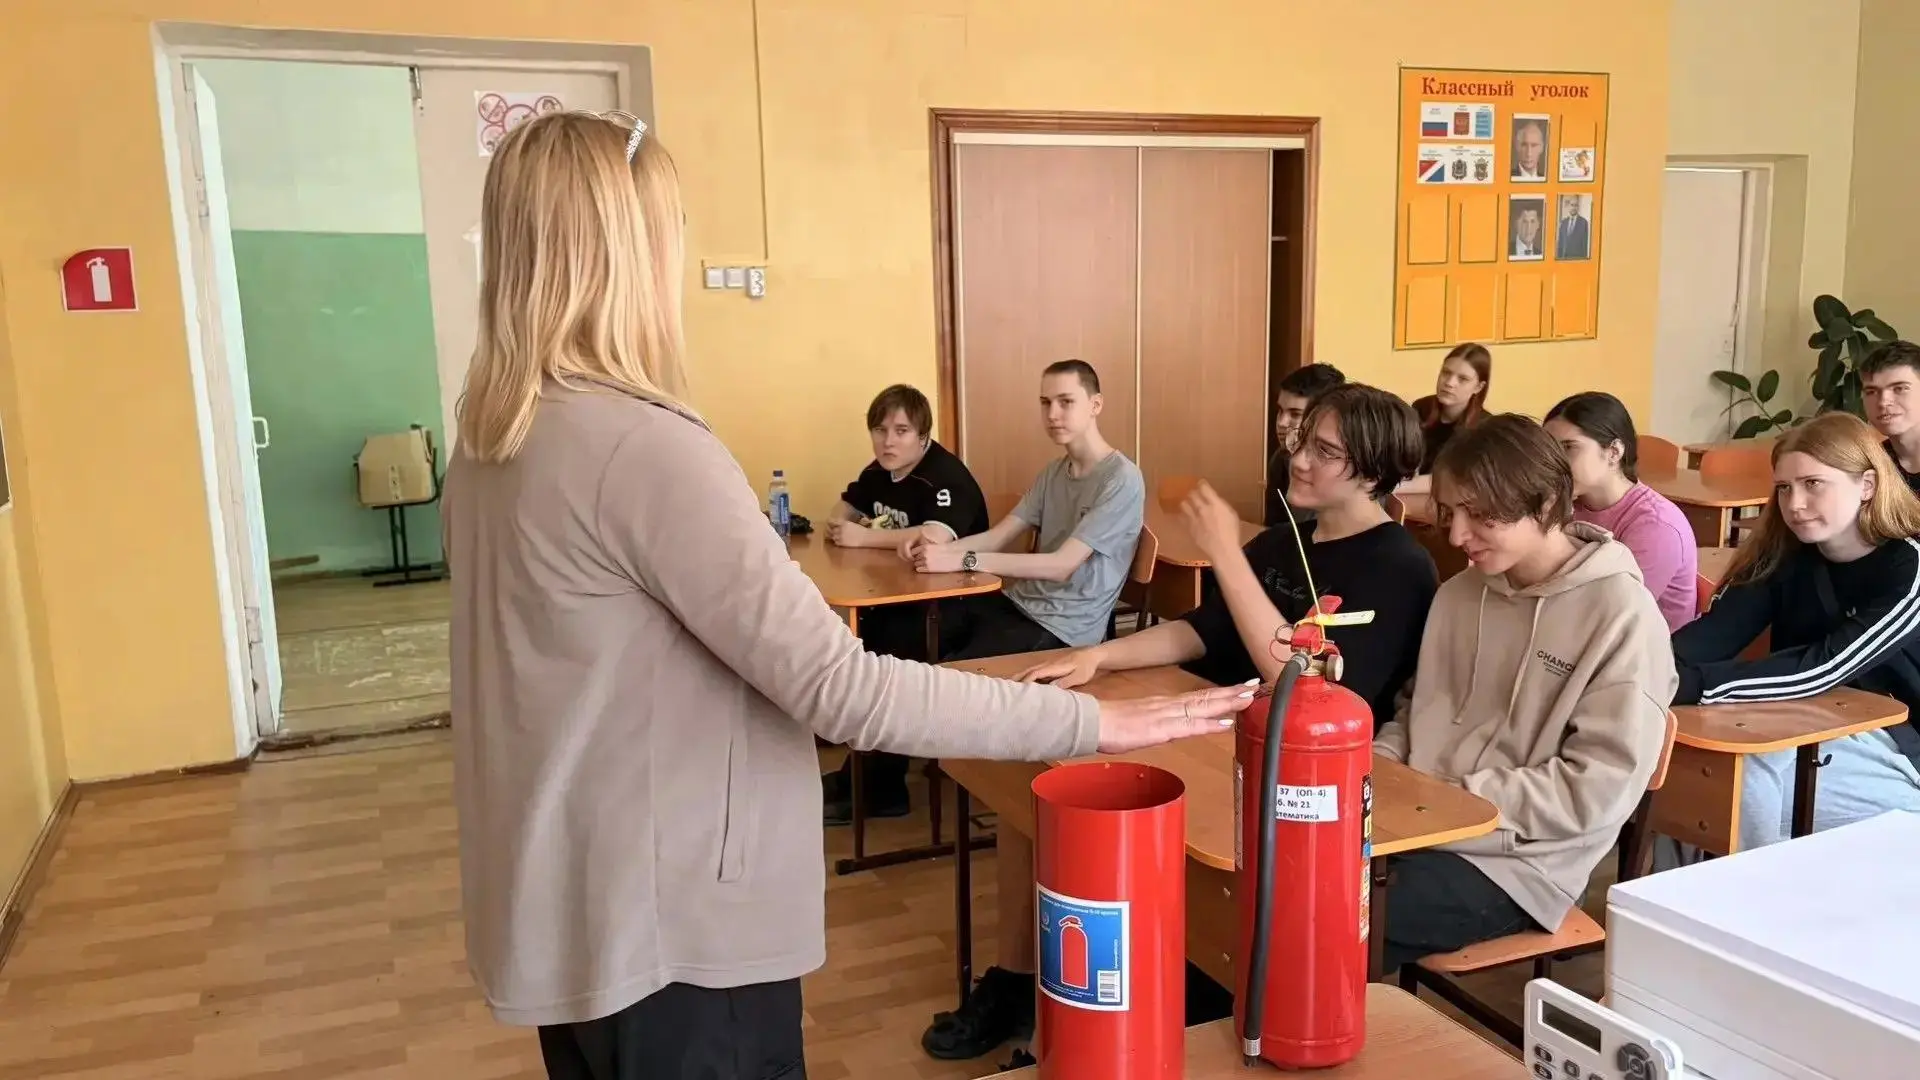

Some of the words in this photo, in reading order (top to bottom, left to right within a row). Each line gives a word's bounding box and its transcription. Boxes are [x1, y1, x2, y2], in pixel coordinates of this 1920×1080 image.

[1421, 77, 1514, 97] Классный
[1530, 84, 1590, 101] уголок
[936, 488, 952, 507] 9
[1536, 650, 1574, 672] CHANC
[1279, 787, 1290, 796] 37
[1287, 799, 1298, 808] №
[1300, 800, 1311, 809] 21
[1275, 810, 1320, 820] атематика
